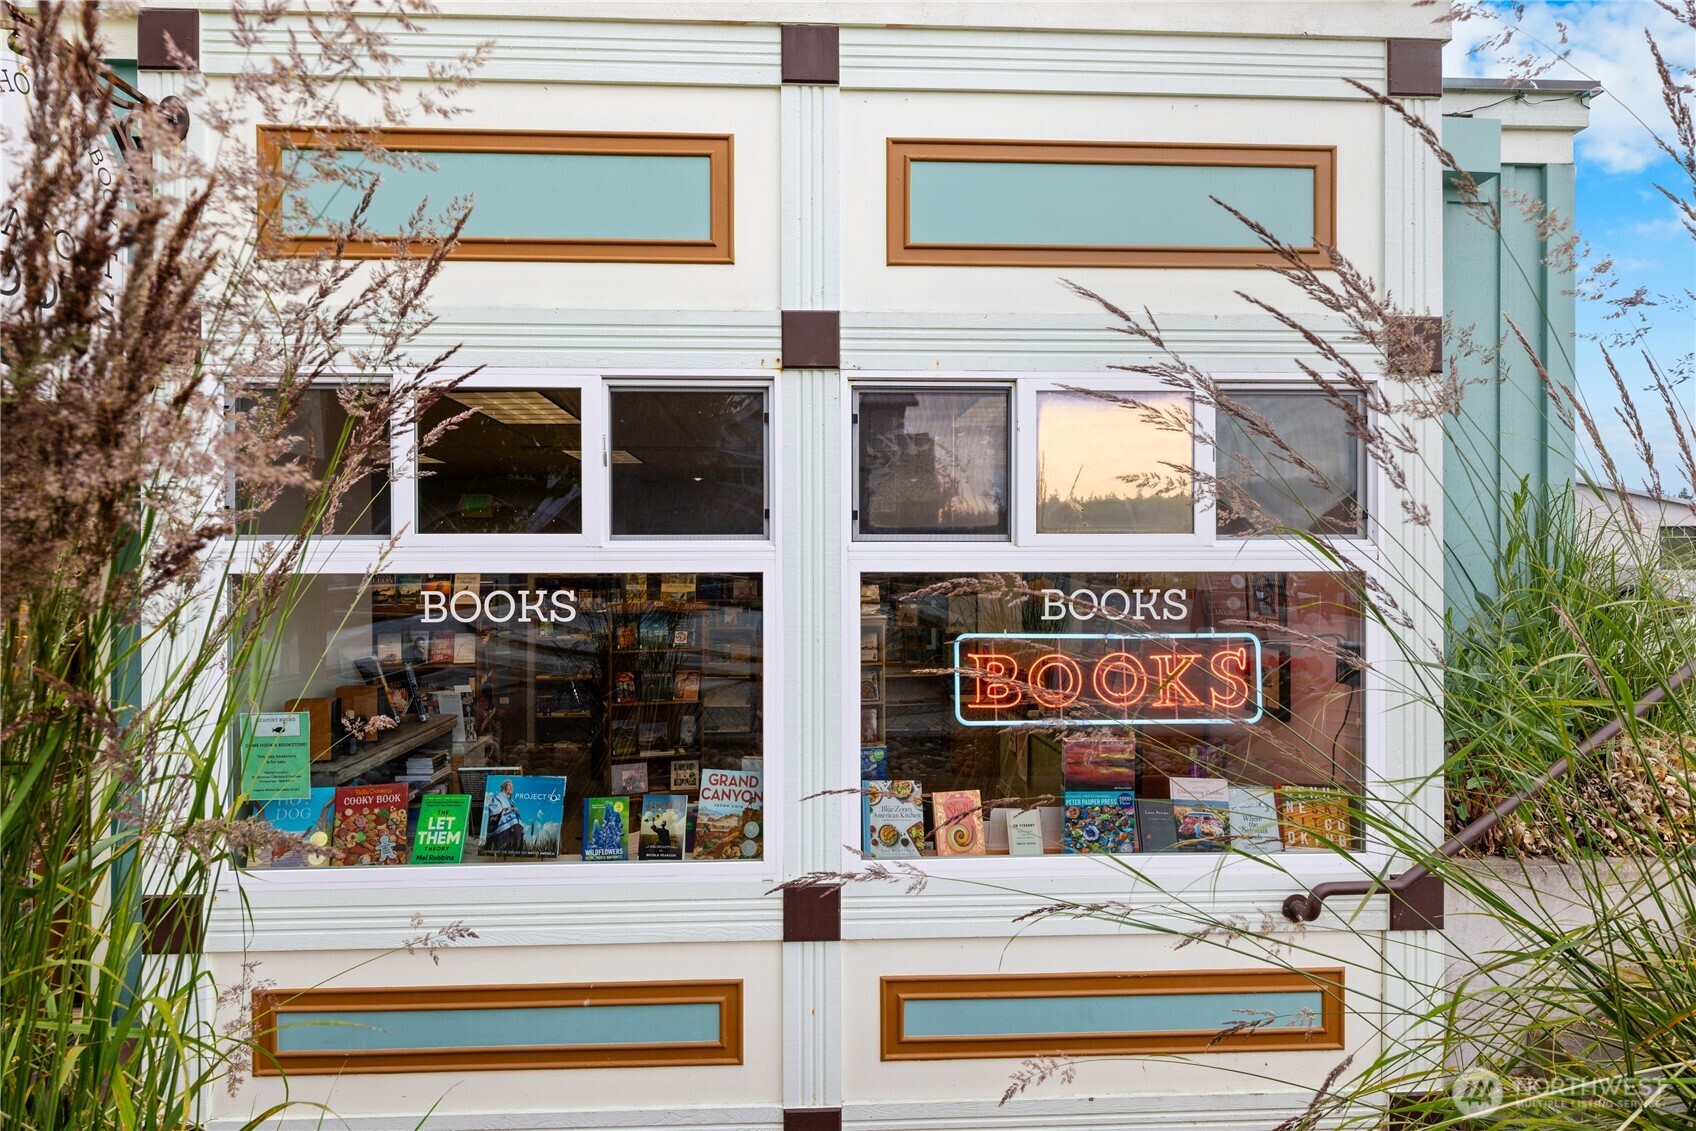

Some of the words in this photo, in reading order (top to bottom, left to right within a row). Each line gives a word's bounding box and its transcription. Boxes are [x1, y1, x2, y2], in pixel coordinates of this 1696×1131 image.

[420, 590, 577, 623] BOOKS
[1040, 588, 1188, 621] BOOKS
[967, 647, 1249, 711] BOOKS
[708, 773, 759, 788] GRAND
[343, 796, 374, 806] COOKY
[376, 794, 401, 804] BOOK
[514, 792, 547, 800] PROJECT
[701, 787, 763, 803] CANYON
[276, 808, 312, 821] DOG
[894, 805, 913, 813] Zones
[427, 816, 456, 830] LET
[417, 831, 462, 845] THEM
[584, 847, 624, 857] WILDFLOWERS
